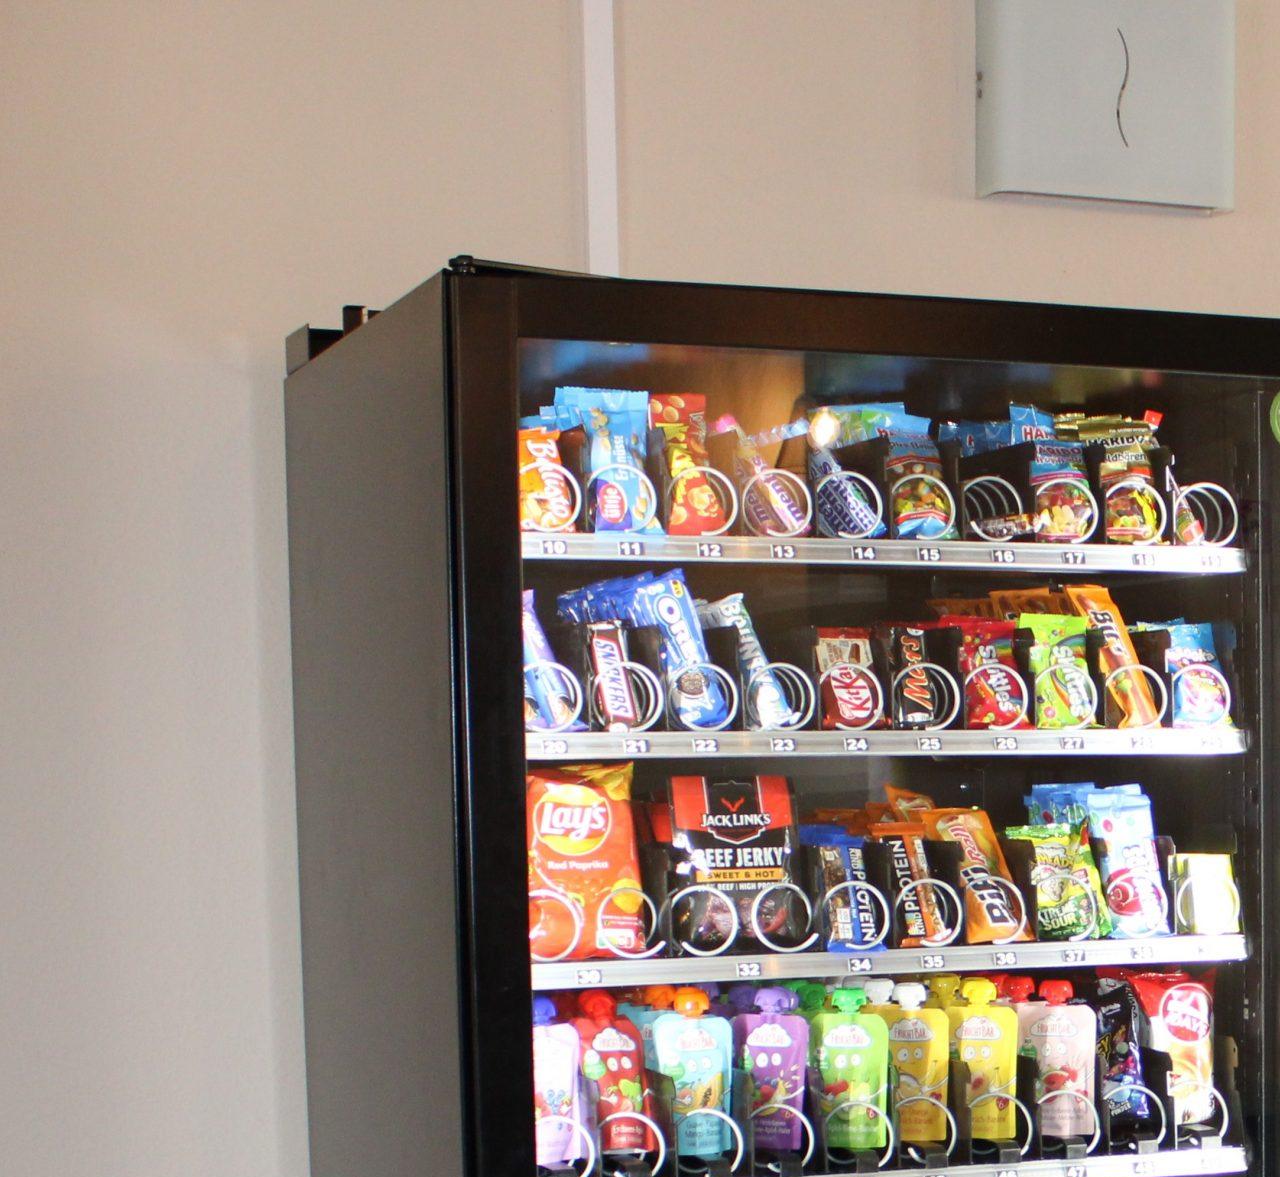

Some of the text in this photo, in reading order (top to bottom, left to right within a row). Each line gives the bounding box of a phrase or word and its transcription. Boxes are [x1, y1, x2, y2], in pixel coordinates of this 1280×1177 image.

[621, 543, 640, 555] 11
[700, 544, 721, 557] 12
[775, 546, 794, 558] 13
[855, 548, 875, 560] 14
[920, 548, 940, 561] 15
[995, 549, 1014, 562] 16
[1065, 552, 1085, 563] 17
[626, 740, 647, 752] 21
[695, 740, 717, 752] 22
[774, 739, 795, 751] 23
[847, 739, 868, 750] 24
[921, 738, 941, 750] 25
[997, 738, 1017, 750] 26
[1064, 737, 1083, 749] 27
[540, 802, 606, 841] Lay's
[701, 813, 771, 827] JACK LINK'S
[736, 847, 782, 867] JERKY
[853, 870, 876, 941] POTEIN
[924, 956, 945, 968] 35
[995, 953, 1016, 965] 36
[1064, 950, 1085, 962] 37
[740, 964, 760, 976] 32
[851, 958, 872, 971] 34
[1068, 1167, 1087, 1177] 47
